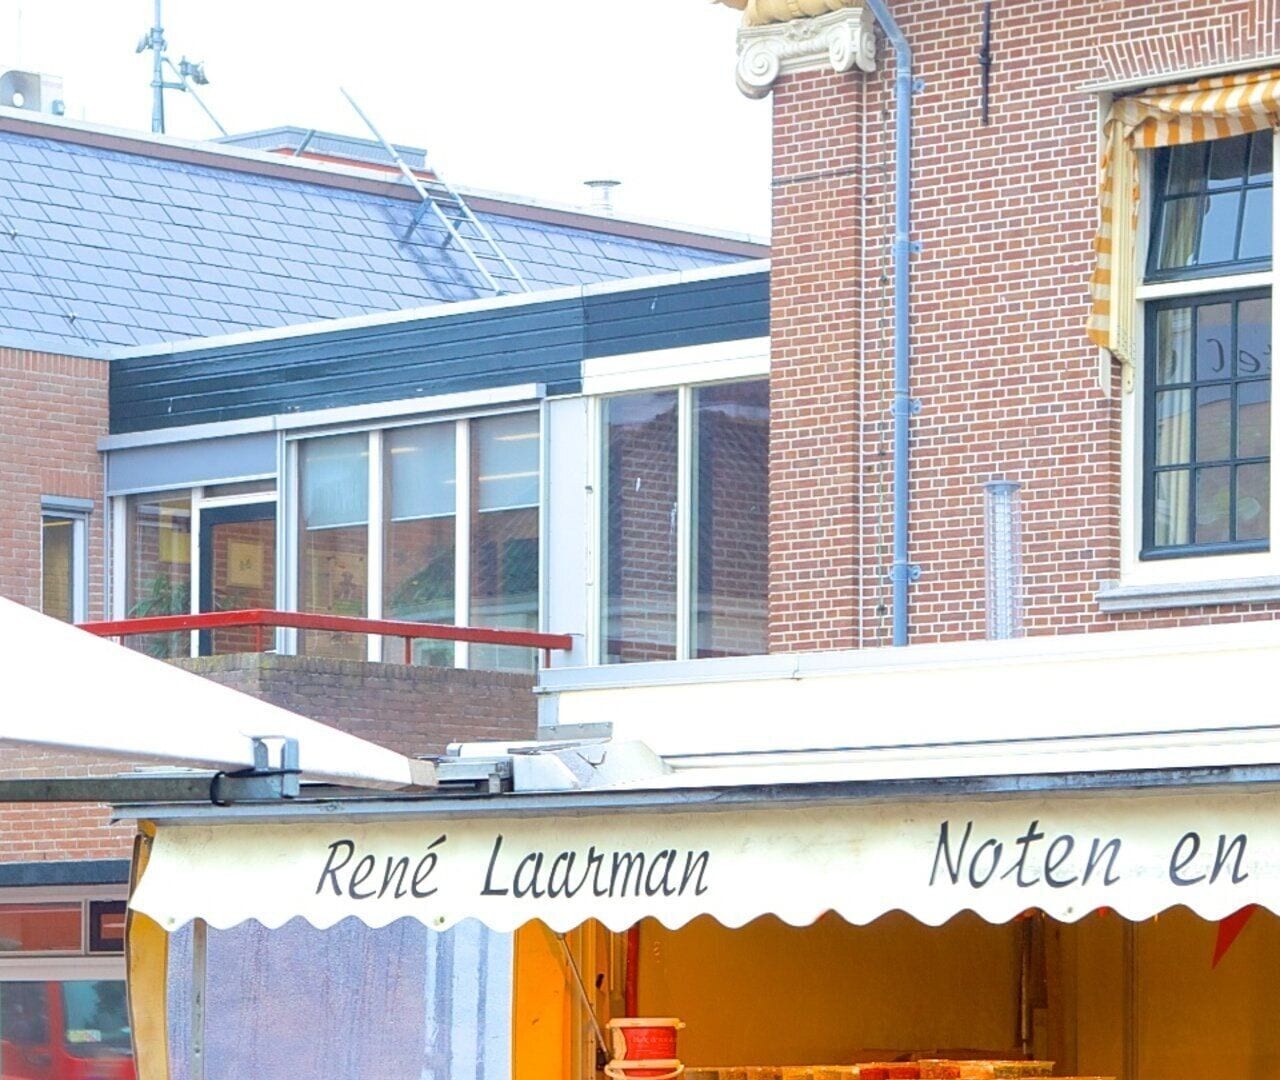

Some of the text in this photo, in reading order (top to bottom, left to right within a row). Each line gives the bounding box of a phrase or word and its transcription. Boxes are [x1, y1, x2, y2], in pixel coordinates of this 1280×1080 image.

[315, 834, 710, 899] René Laarman
[929, 819, 1120, 889] Noten
[1167, 832, 1248, 883] en
